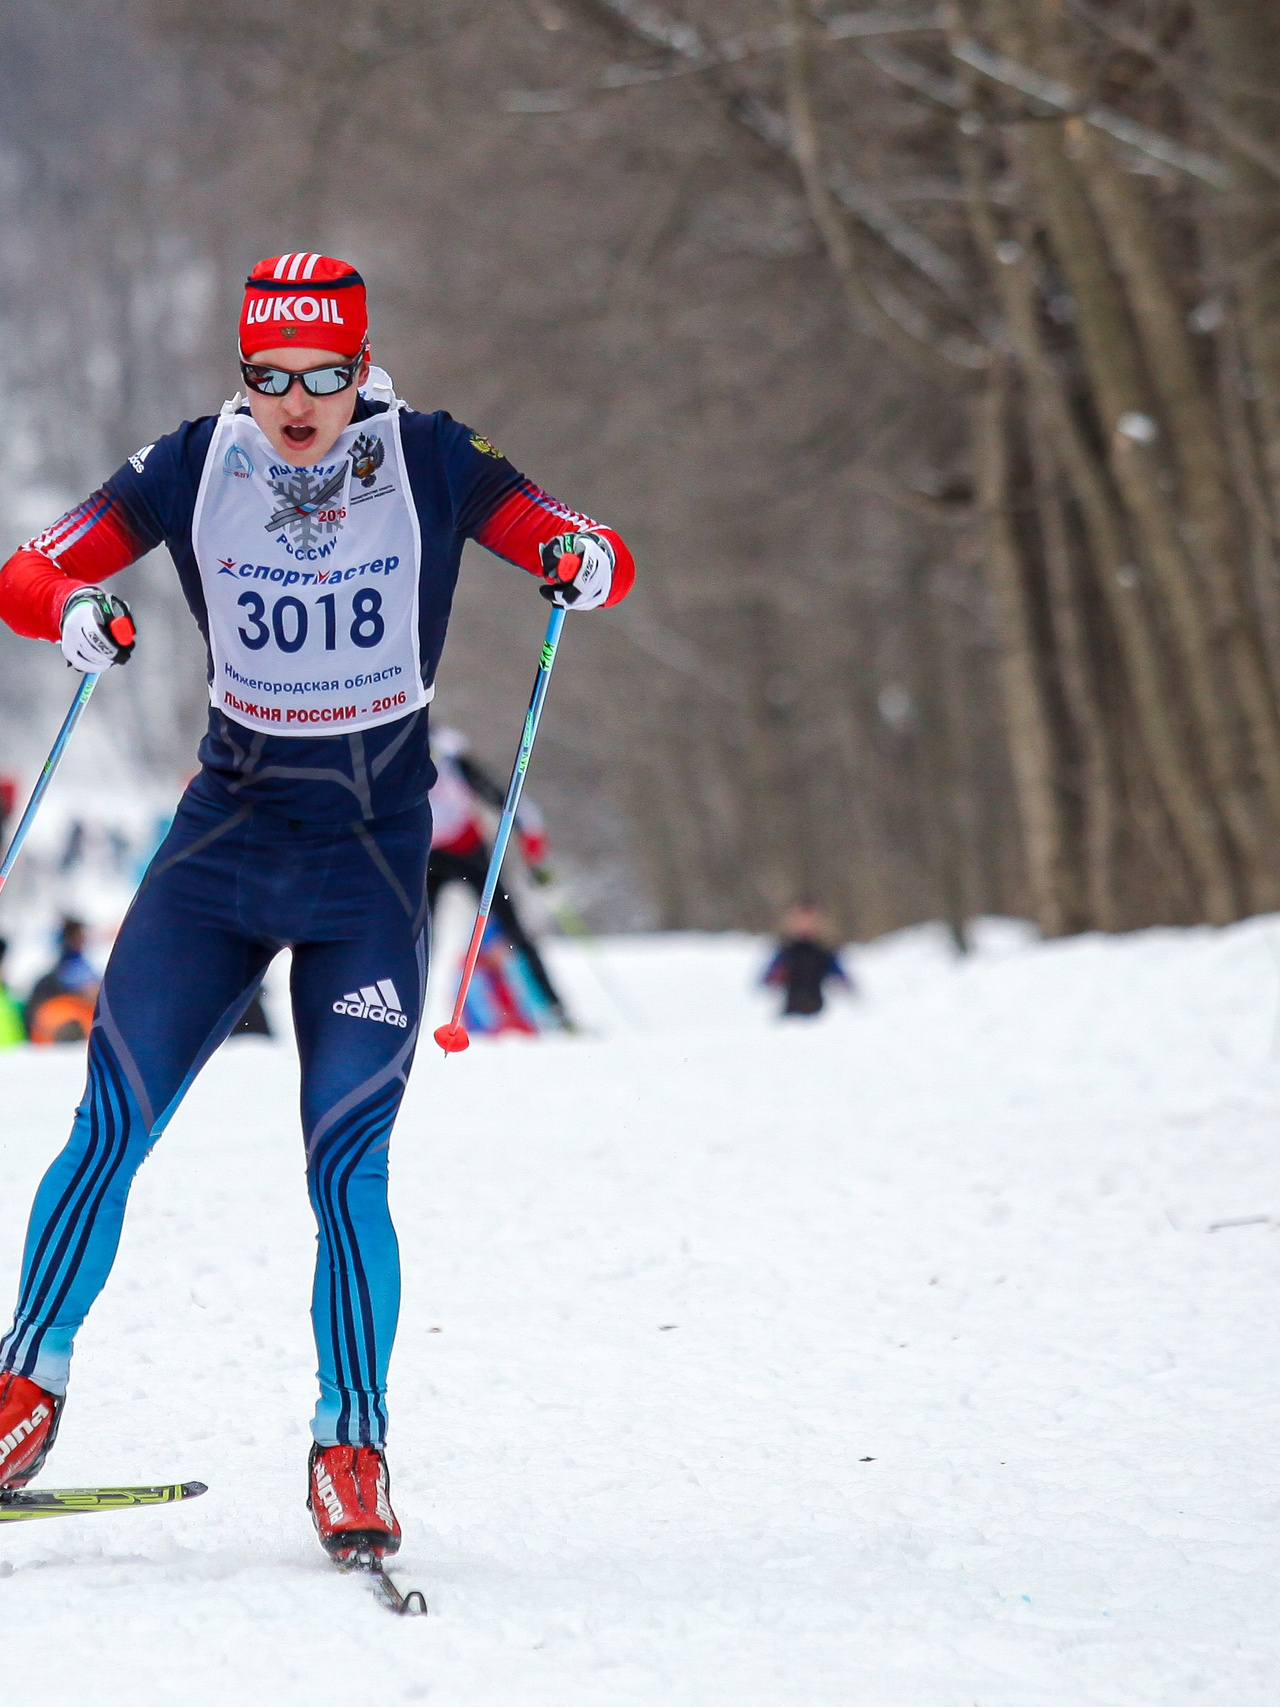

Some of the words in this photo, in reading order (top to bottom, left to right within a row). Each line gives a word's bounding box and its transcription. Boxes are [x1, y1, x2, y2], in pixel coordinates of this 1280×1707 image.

[247, 296, 344, 325] LUKOIL
[276, 533, 338, 561] РОССИИ
[237, 587, 385, 653] 3018
[225, 662, 340, 695] Нижегородская
[344, 665, 402, 690] область
[224, 691, 281, 722] ЛЫЖНЯ
[286, 705, 356, 723] РОССИИ
[371, 690, 407, 714] 2016
[332, 1001, 408, 1029] adidas
